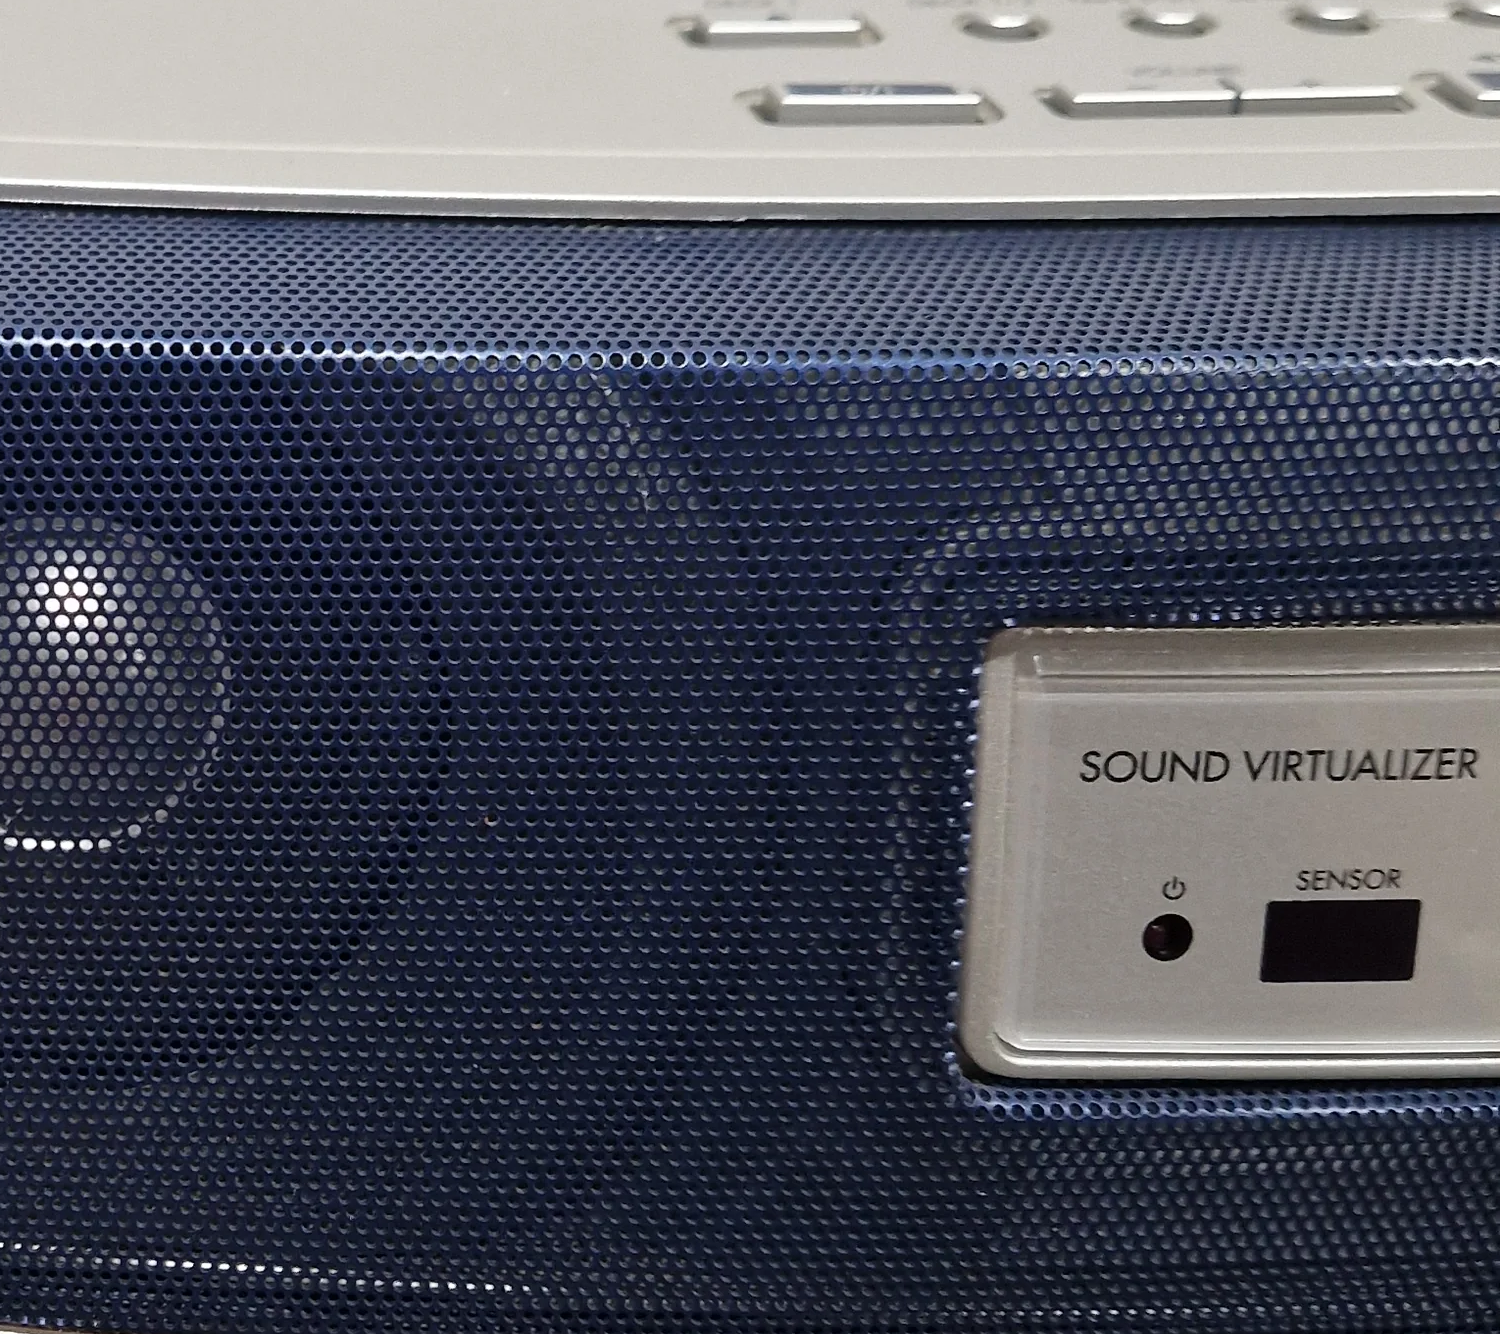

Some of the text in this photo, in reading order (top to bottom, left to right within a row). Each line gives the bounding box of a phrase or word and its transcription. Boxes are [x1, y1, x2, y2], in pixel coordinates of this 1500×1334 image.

[1079, 747, 1480, 784] SOUND VIRTUALIZER
[1295, 868, 1402, 892] SENSOR
